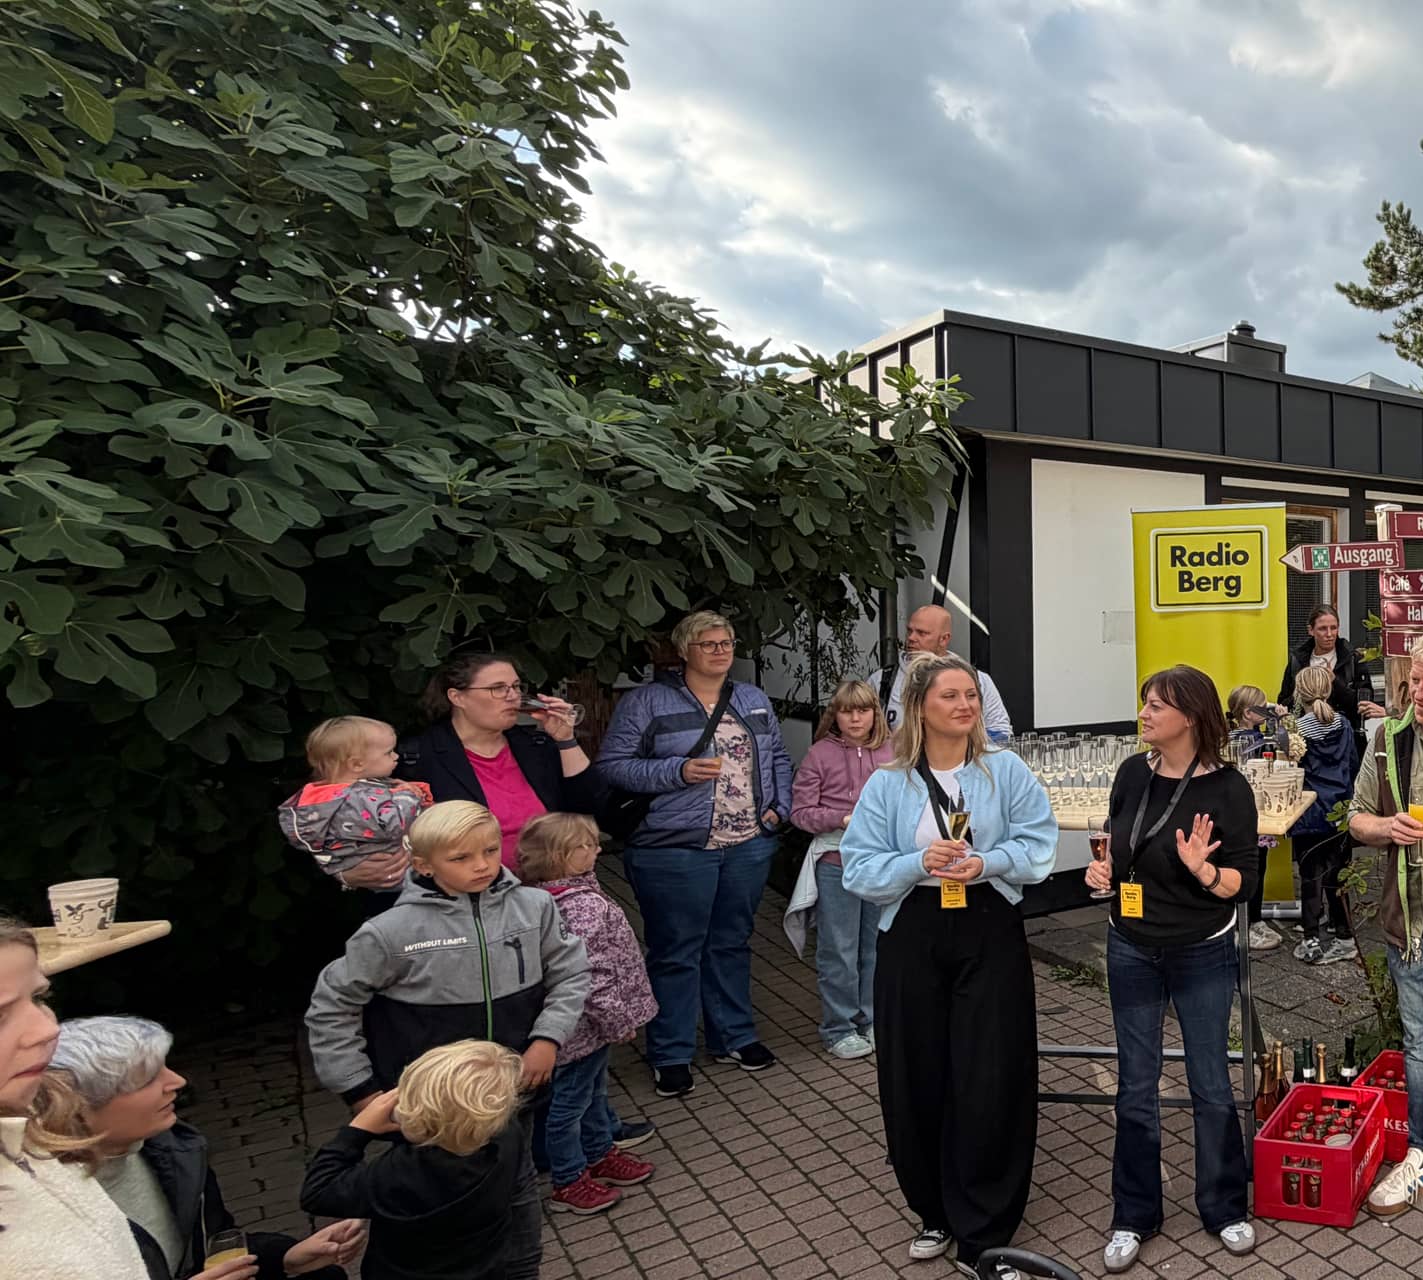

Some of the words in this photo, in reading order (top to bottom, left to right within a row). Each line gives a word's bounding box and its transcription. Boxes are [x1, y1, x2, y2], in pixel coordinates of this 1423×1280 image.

[1170, 542, 1249, 567] Radio
[1334, 546, 1394, 566] Ausgang
[1178, 570, 1241, 598] Berg
[1389, 574, 1410, 591] Café
[404, 939, 441, 952] WITHOUT
[443, 937, 468, 946] LIMITS
